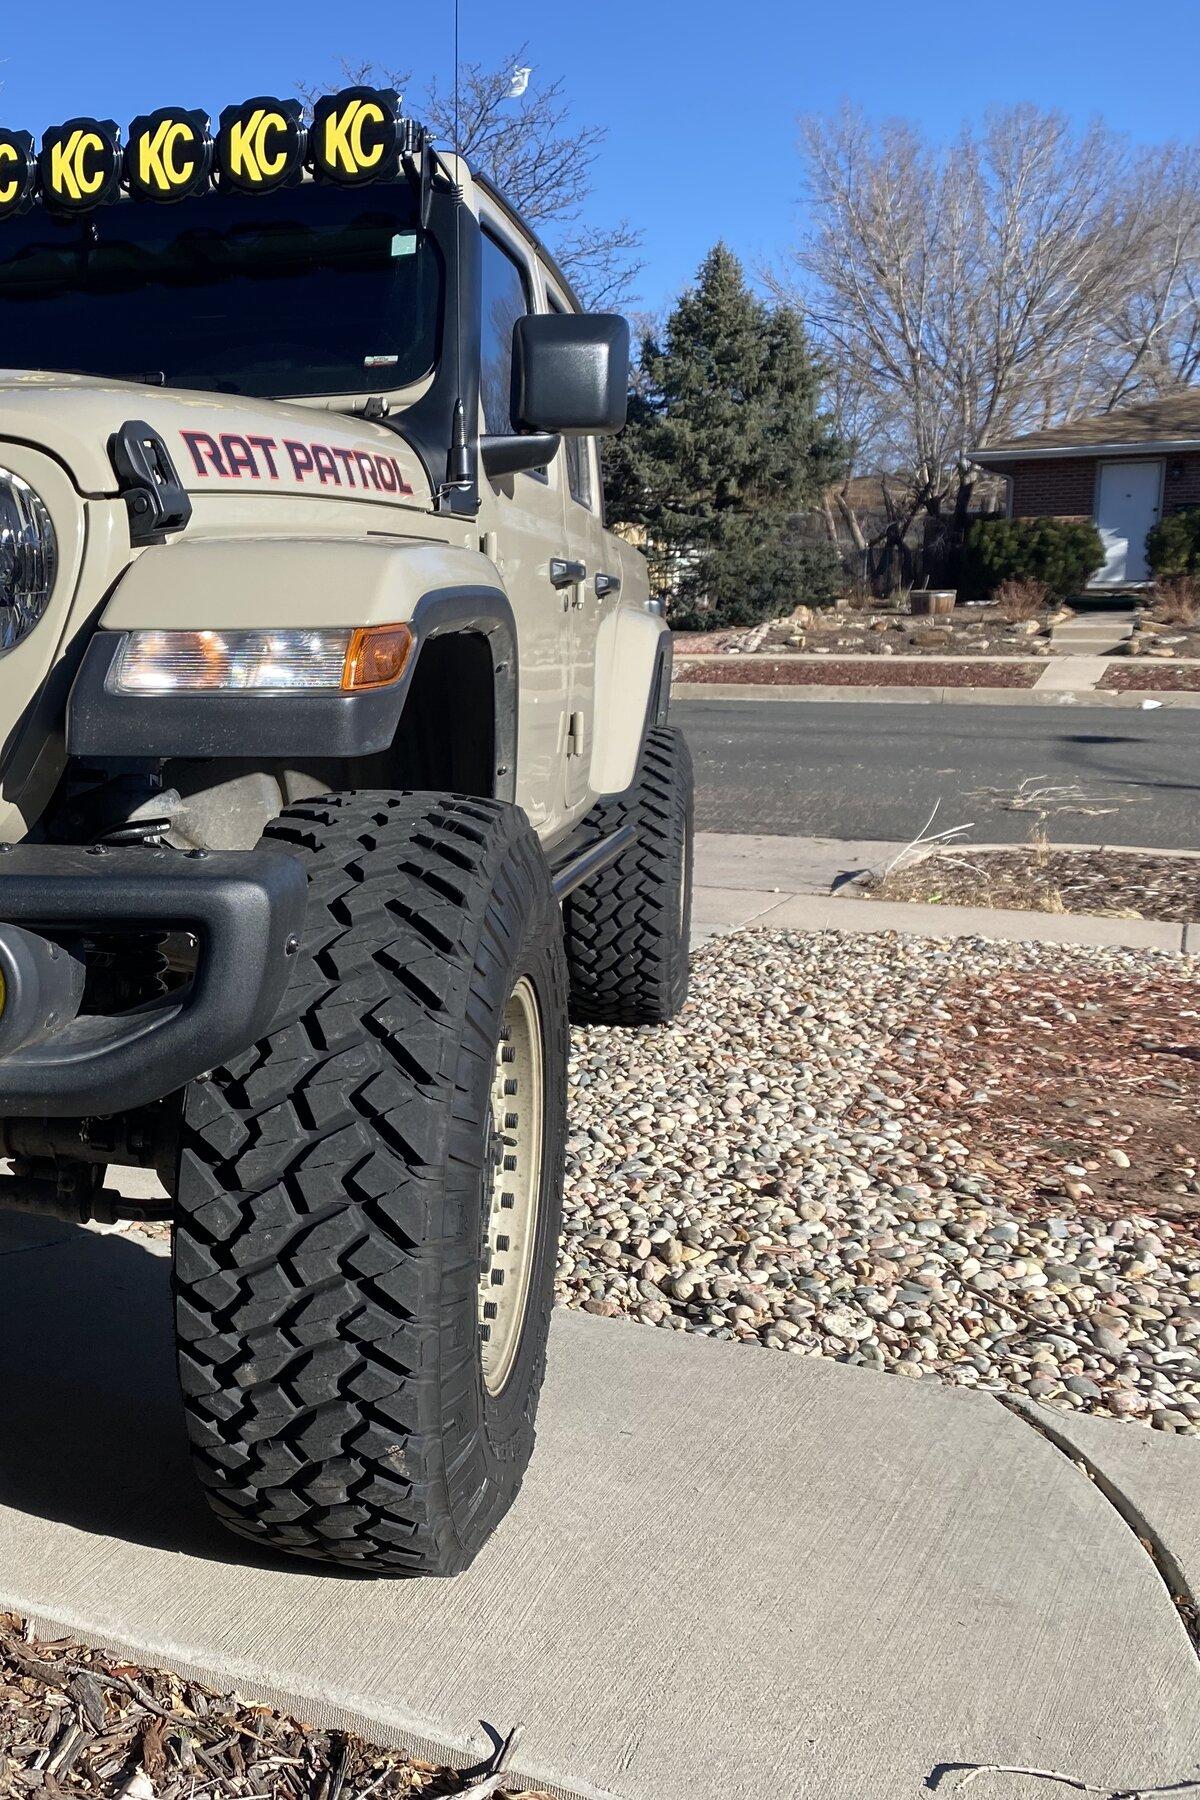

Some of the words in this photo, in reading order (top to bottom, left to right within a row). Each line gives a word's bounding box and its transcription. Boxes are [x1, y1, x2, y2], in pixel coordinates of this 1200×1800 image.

[51, 131, 105, 199] KC
[139, 120, 194, 190] KC
[230, 111, 287, 182] KC
[325, 101, 384, 174] KC
[179, 430, 280, 480] RAT
[282, 438, 414, 496] PATROL
